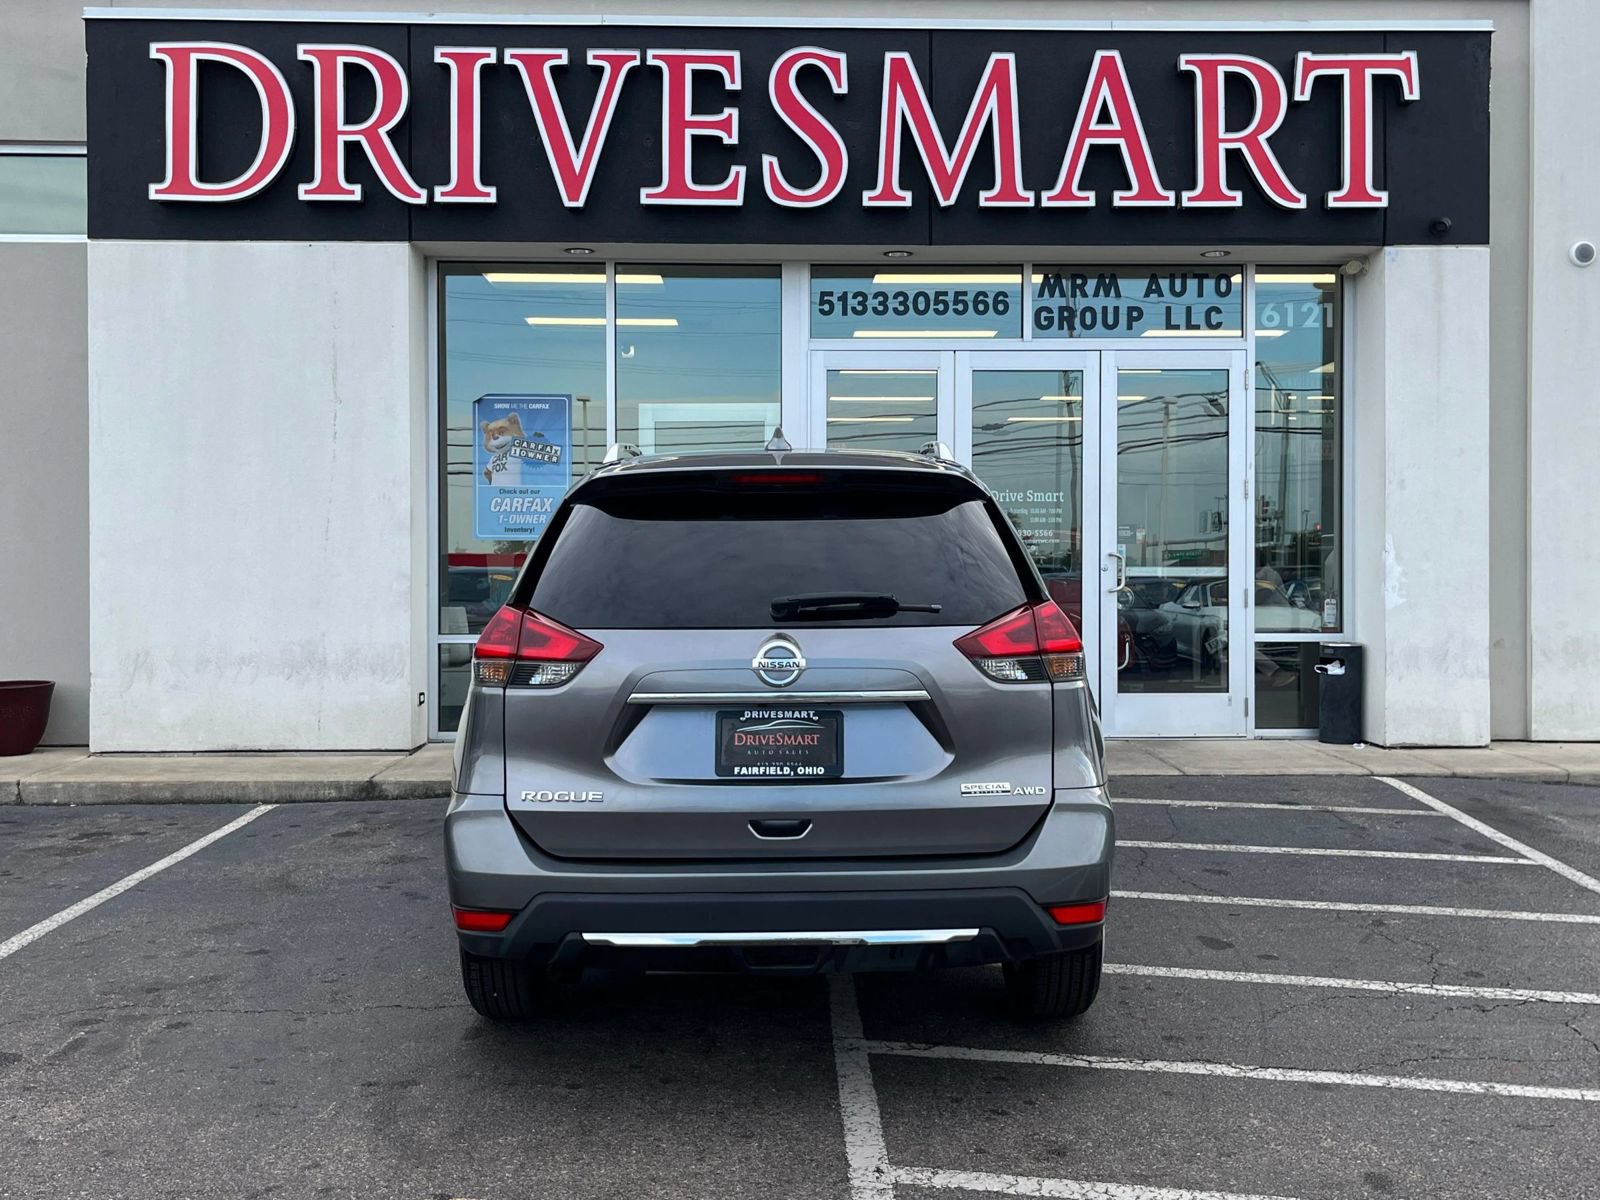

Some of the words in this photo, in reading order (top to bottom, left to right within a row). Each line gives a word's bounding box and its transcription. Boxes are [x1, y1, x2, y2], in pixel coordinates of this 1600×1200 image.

[148, 41, 1420, 210] DRIVESMART
[1037, 273, 1121, 298] MRM
[1143, 273, 1233, 298] AUTO
[818, 290, 1010, 317] 5133305566
[1034, 305, 1144, 331] GROUP
[1165, 305, 1224, 331] LLC
[1260, 302, 1334, 328] 6121
[513, 439, 560, 455] CARFAX
[1026, 489, 1064, 502] Smart
[490, 497, 553, 512] CARFAX
[499, 514, 547, 524] 1-OWNER
[504, 526, 535, 534] Inventory!
[757, 660, 800, 669] NISSAN
[744, 710, 816, 719] DRIVESMART
[734, 766, 794, 776] FAIRFIELD,
[797, 766, 825, 775] OHIO
[521, 790, 604, 802] ROGUE
[1013, 786, 1046, 794] AWD
